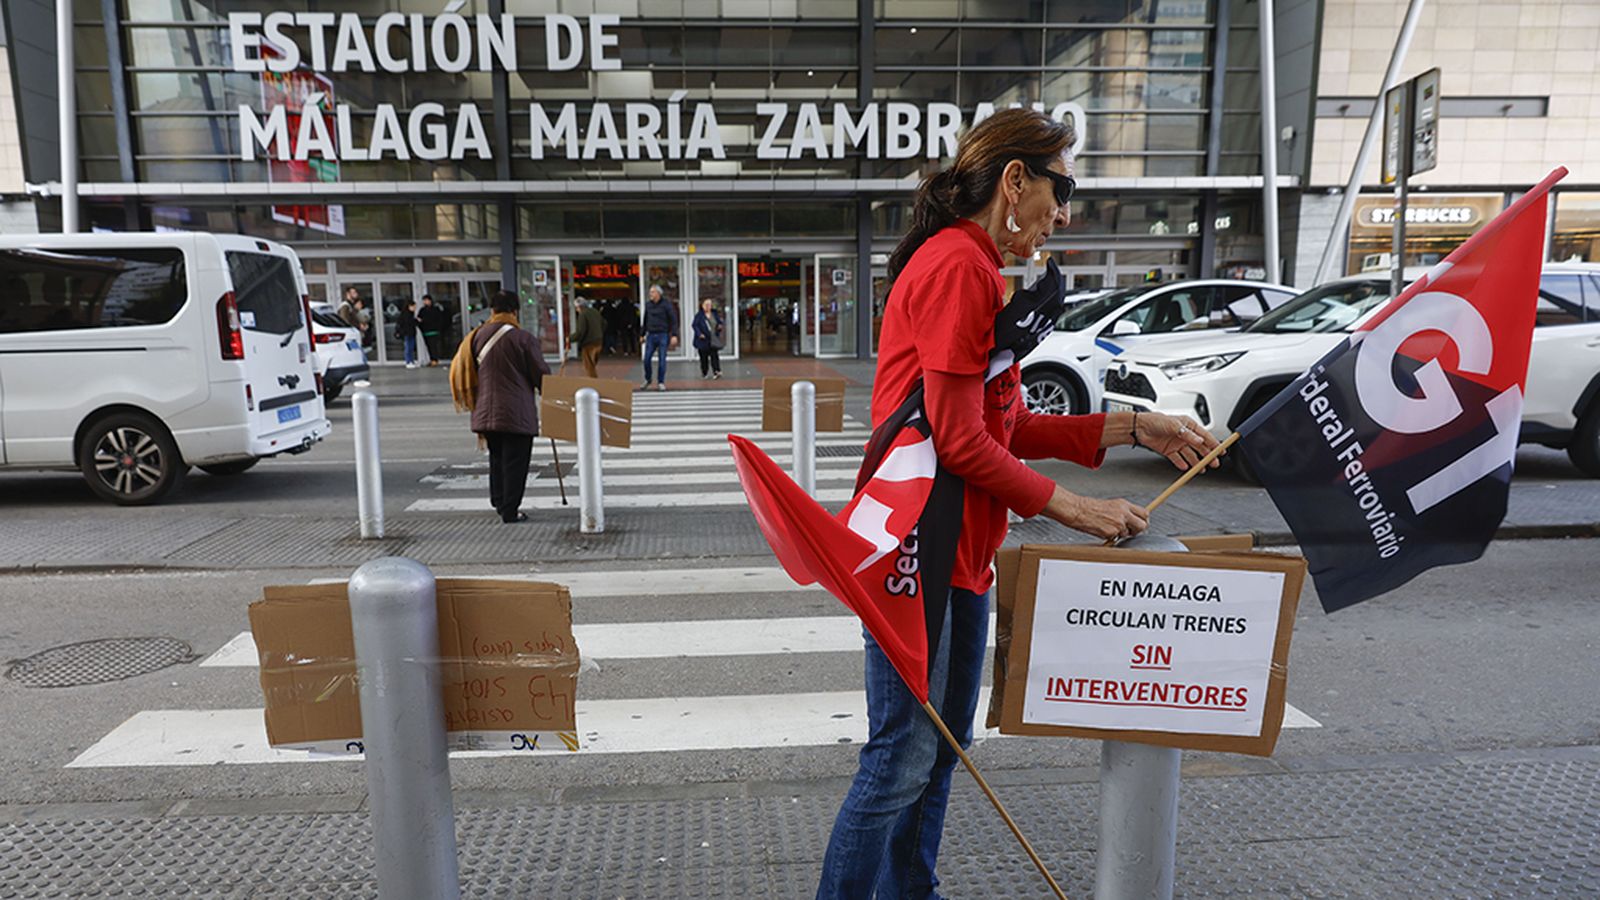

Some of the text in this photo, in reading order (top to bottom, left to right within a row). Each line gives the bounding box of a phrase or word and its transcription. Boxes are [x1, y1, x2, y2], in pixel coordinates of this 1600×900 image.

[228, 0, 623, 72] ESTACIÓN DE
[238, 89, 1088, 162] MÁLAGA MARÍA ZAMBRO
[1371, 207, 1471, 223] STRBUCKS
[1336, 441, 1402, 559] Ferroviario
[1100, 580, 1221, 602] EN MALAGA
[1066, 608, 1247, 634] CIRCULAN TRENES
[1131, 644, 1173, 666] SIN
[1046, 677, 1248, 707] INTERVENTORES
